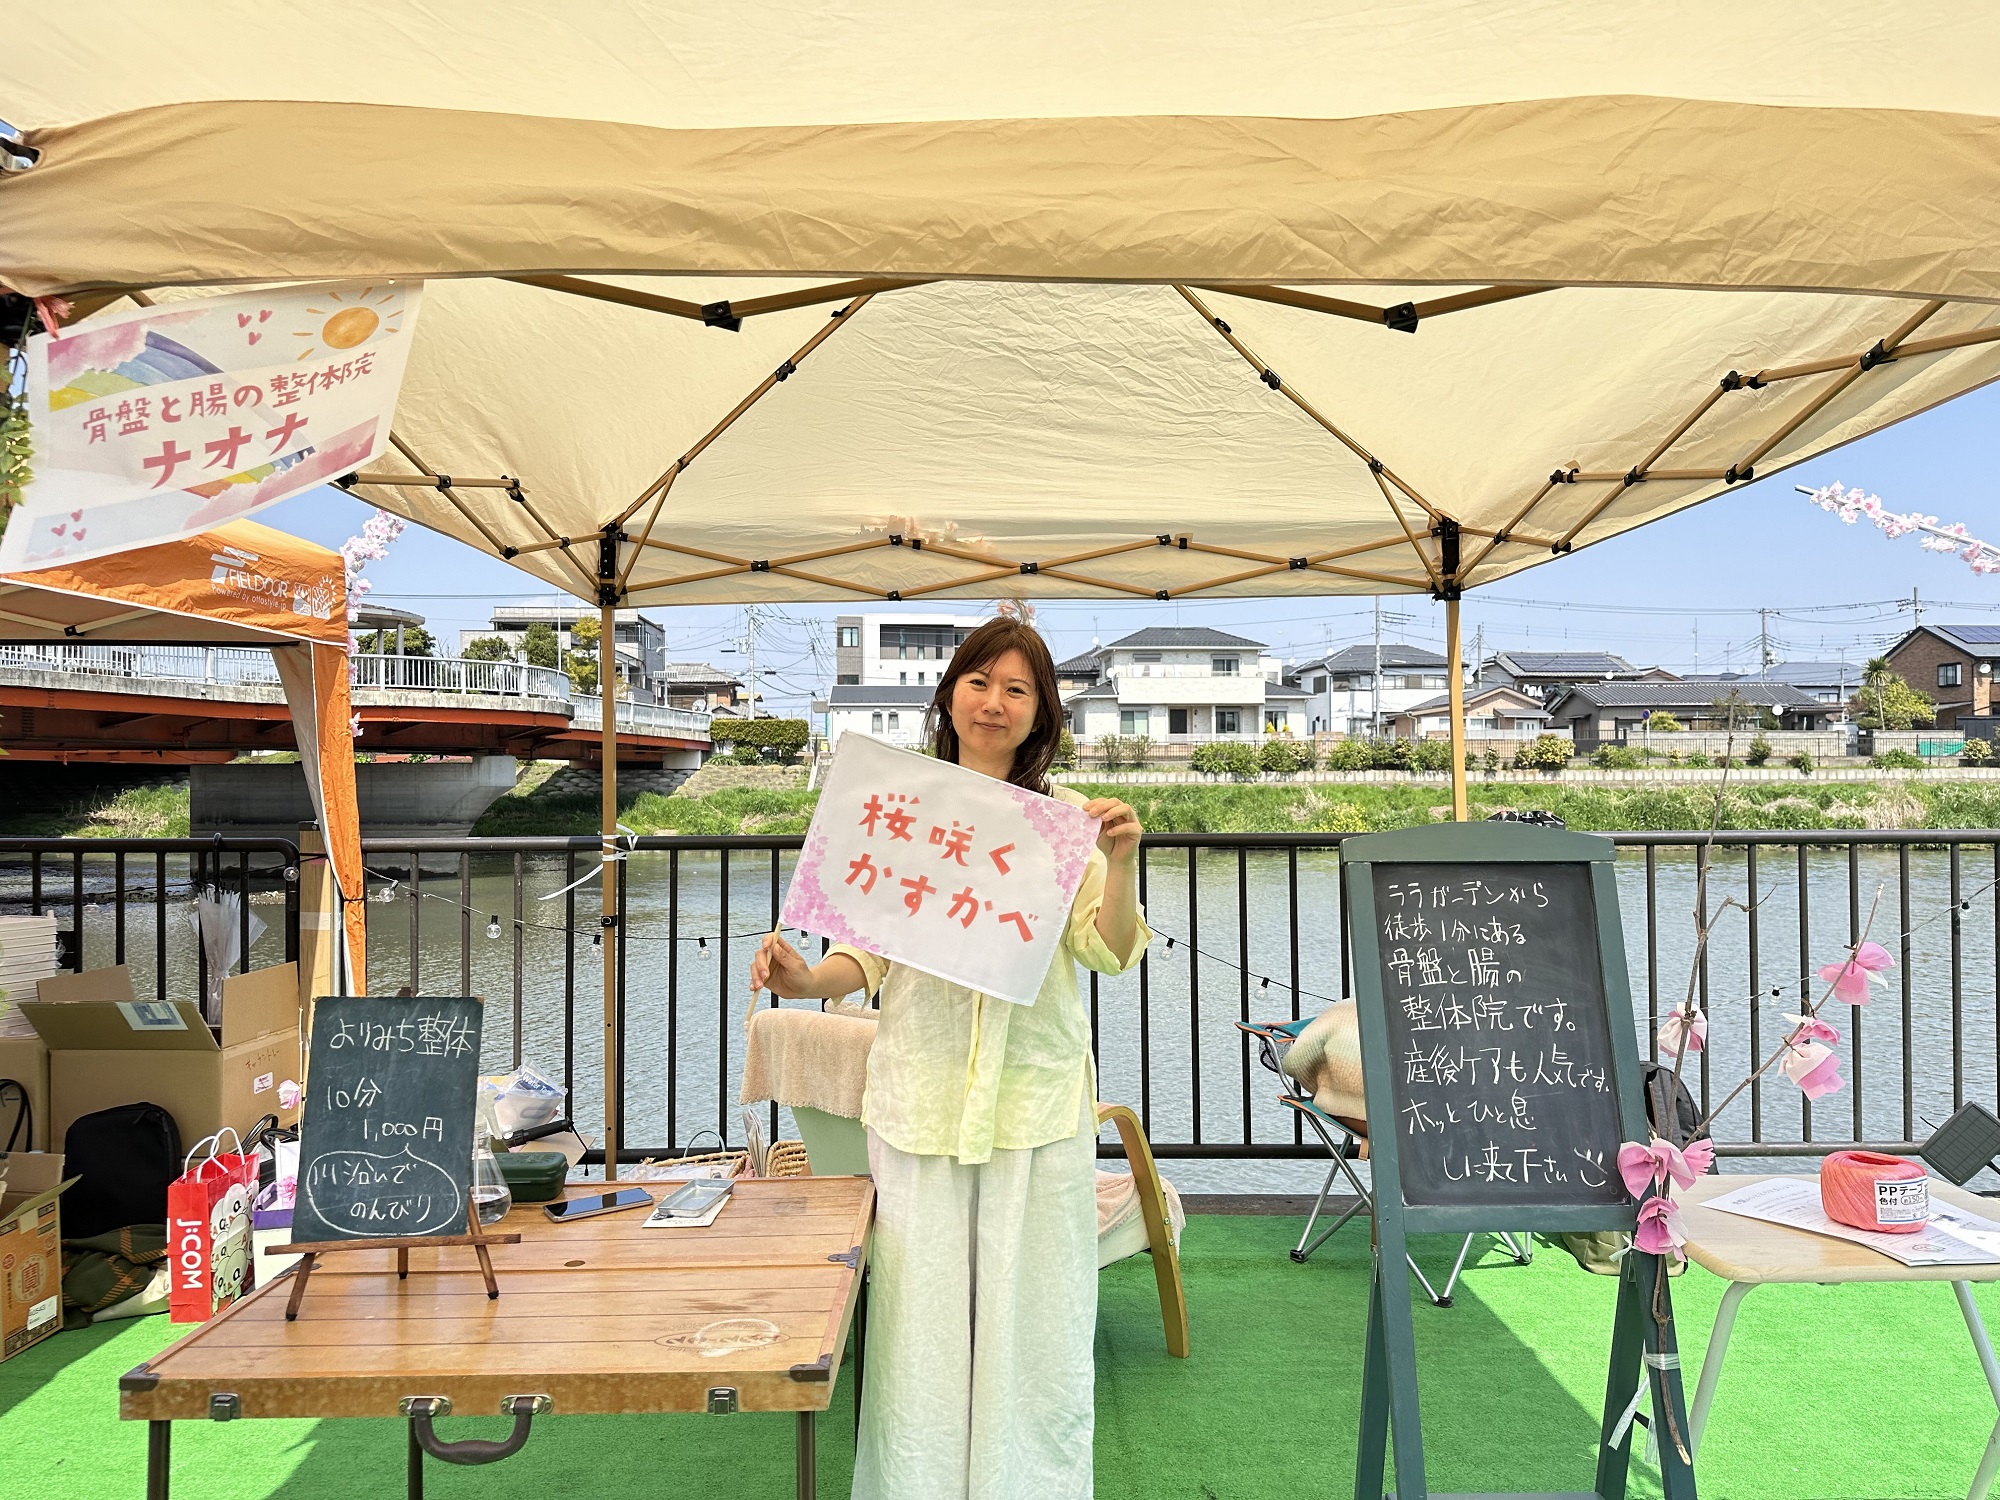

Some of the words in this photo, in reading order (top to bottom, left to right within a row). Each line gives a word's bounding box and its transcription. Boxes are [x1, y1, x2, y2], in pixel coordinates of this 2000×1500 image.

[82, 352, 377, 445] 骨盤と腸の整体院
[143, 412, 309, 489] ナオナ
[229, 568, 287, 598] FIELDOOR
[858, 793, 1016, 876] 桜咲く
[844, 852, 1039, 943] かすかべ
[1388, 880, 1549, 908] ララガーデンから
[1384, 914, 1527, 945] 徒歩1分にある
[1387, 947, 1522, 989] 骨盤と腸の
[1401, 993, 1577, 1032] 整体院です。
[330, 1011, 476, 1058] よりみち整体
[327, 1077, 382, 1110] 10分
[363, 1116, 443, 1142] 1,000円
[313, 1159, 417, 1186] 川沿いで
[350, 1195, 431, 1223] のんびり
[1879, 1197, 1898, 1205] 色付
[176, 1218, 203, 1289] J:COM
